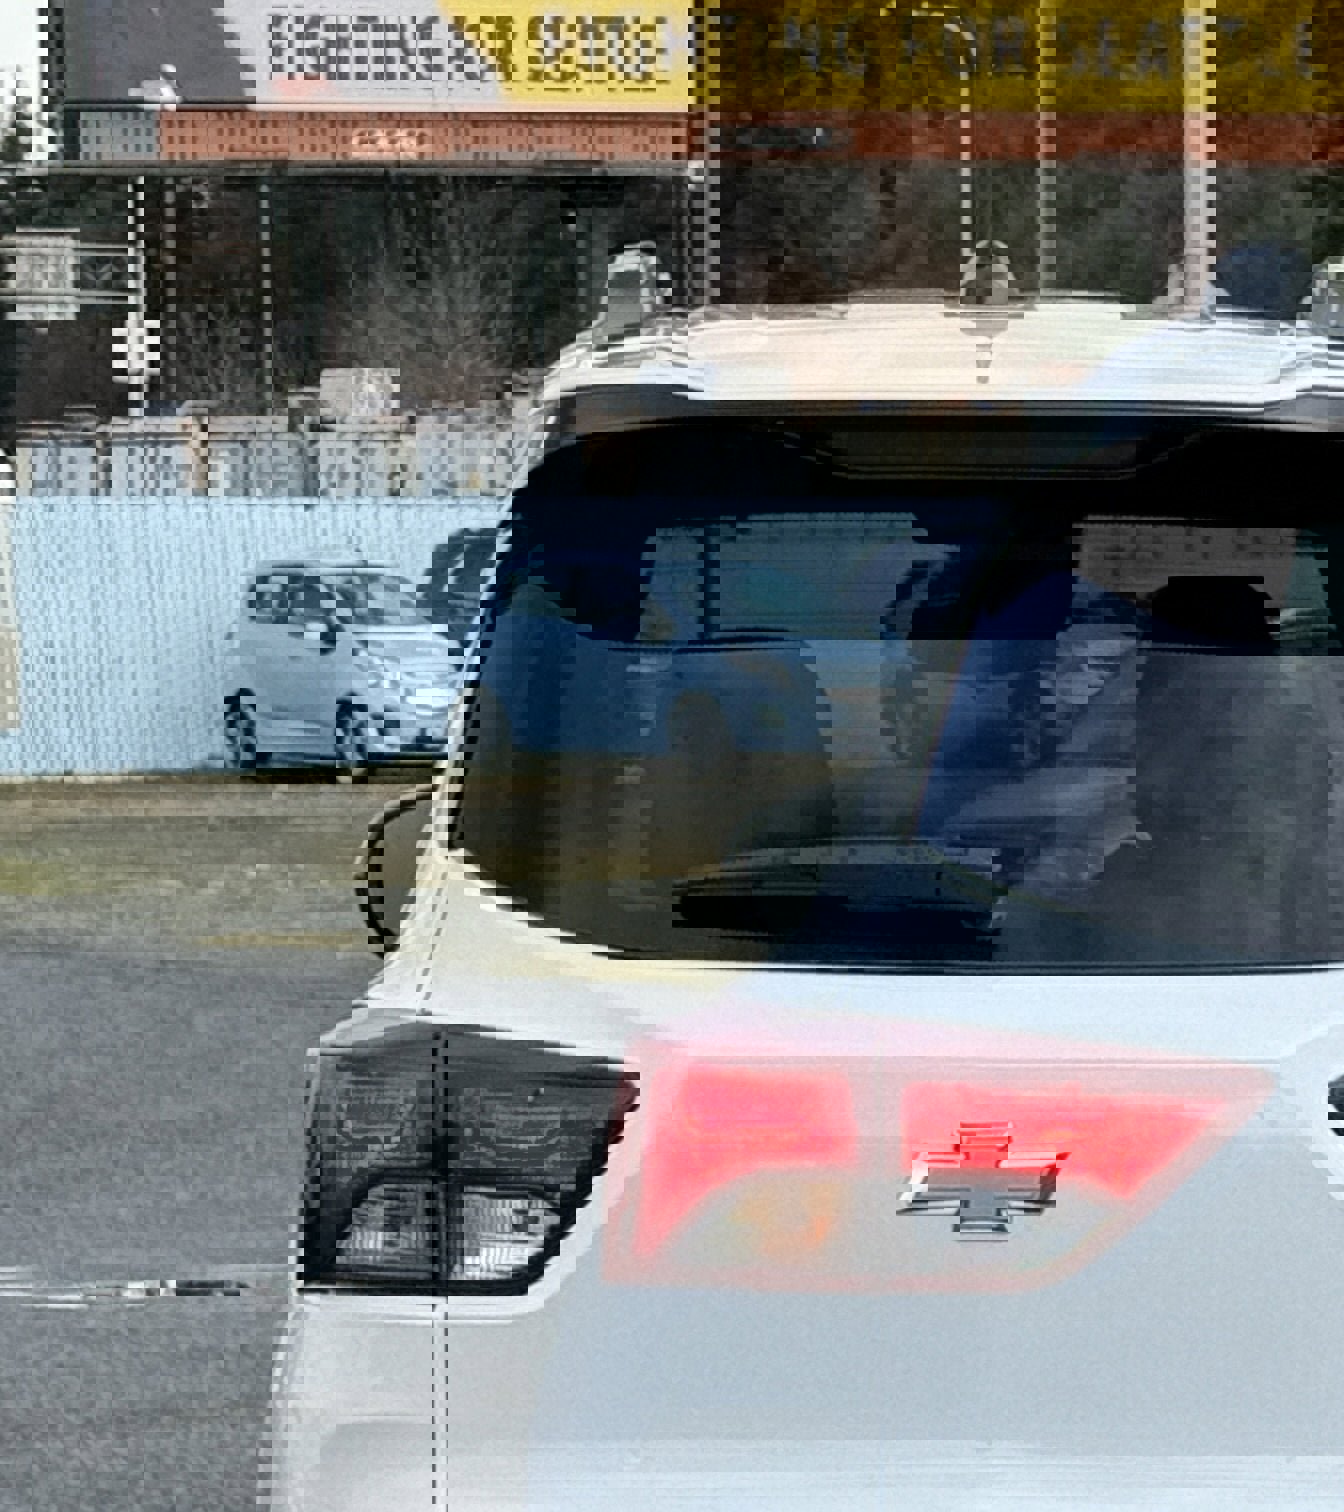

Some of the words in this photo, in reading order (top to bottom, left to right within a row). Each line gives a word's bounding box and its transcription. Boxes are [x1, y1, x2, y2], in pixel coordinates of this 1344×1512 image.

[540, 6, 878, 82] FIGHTING
[901, 11, 1033, 82] FOR
[1053, 12, 1326, 84] SEATTLE
